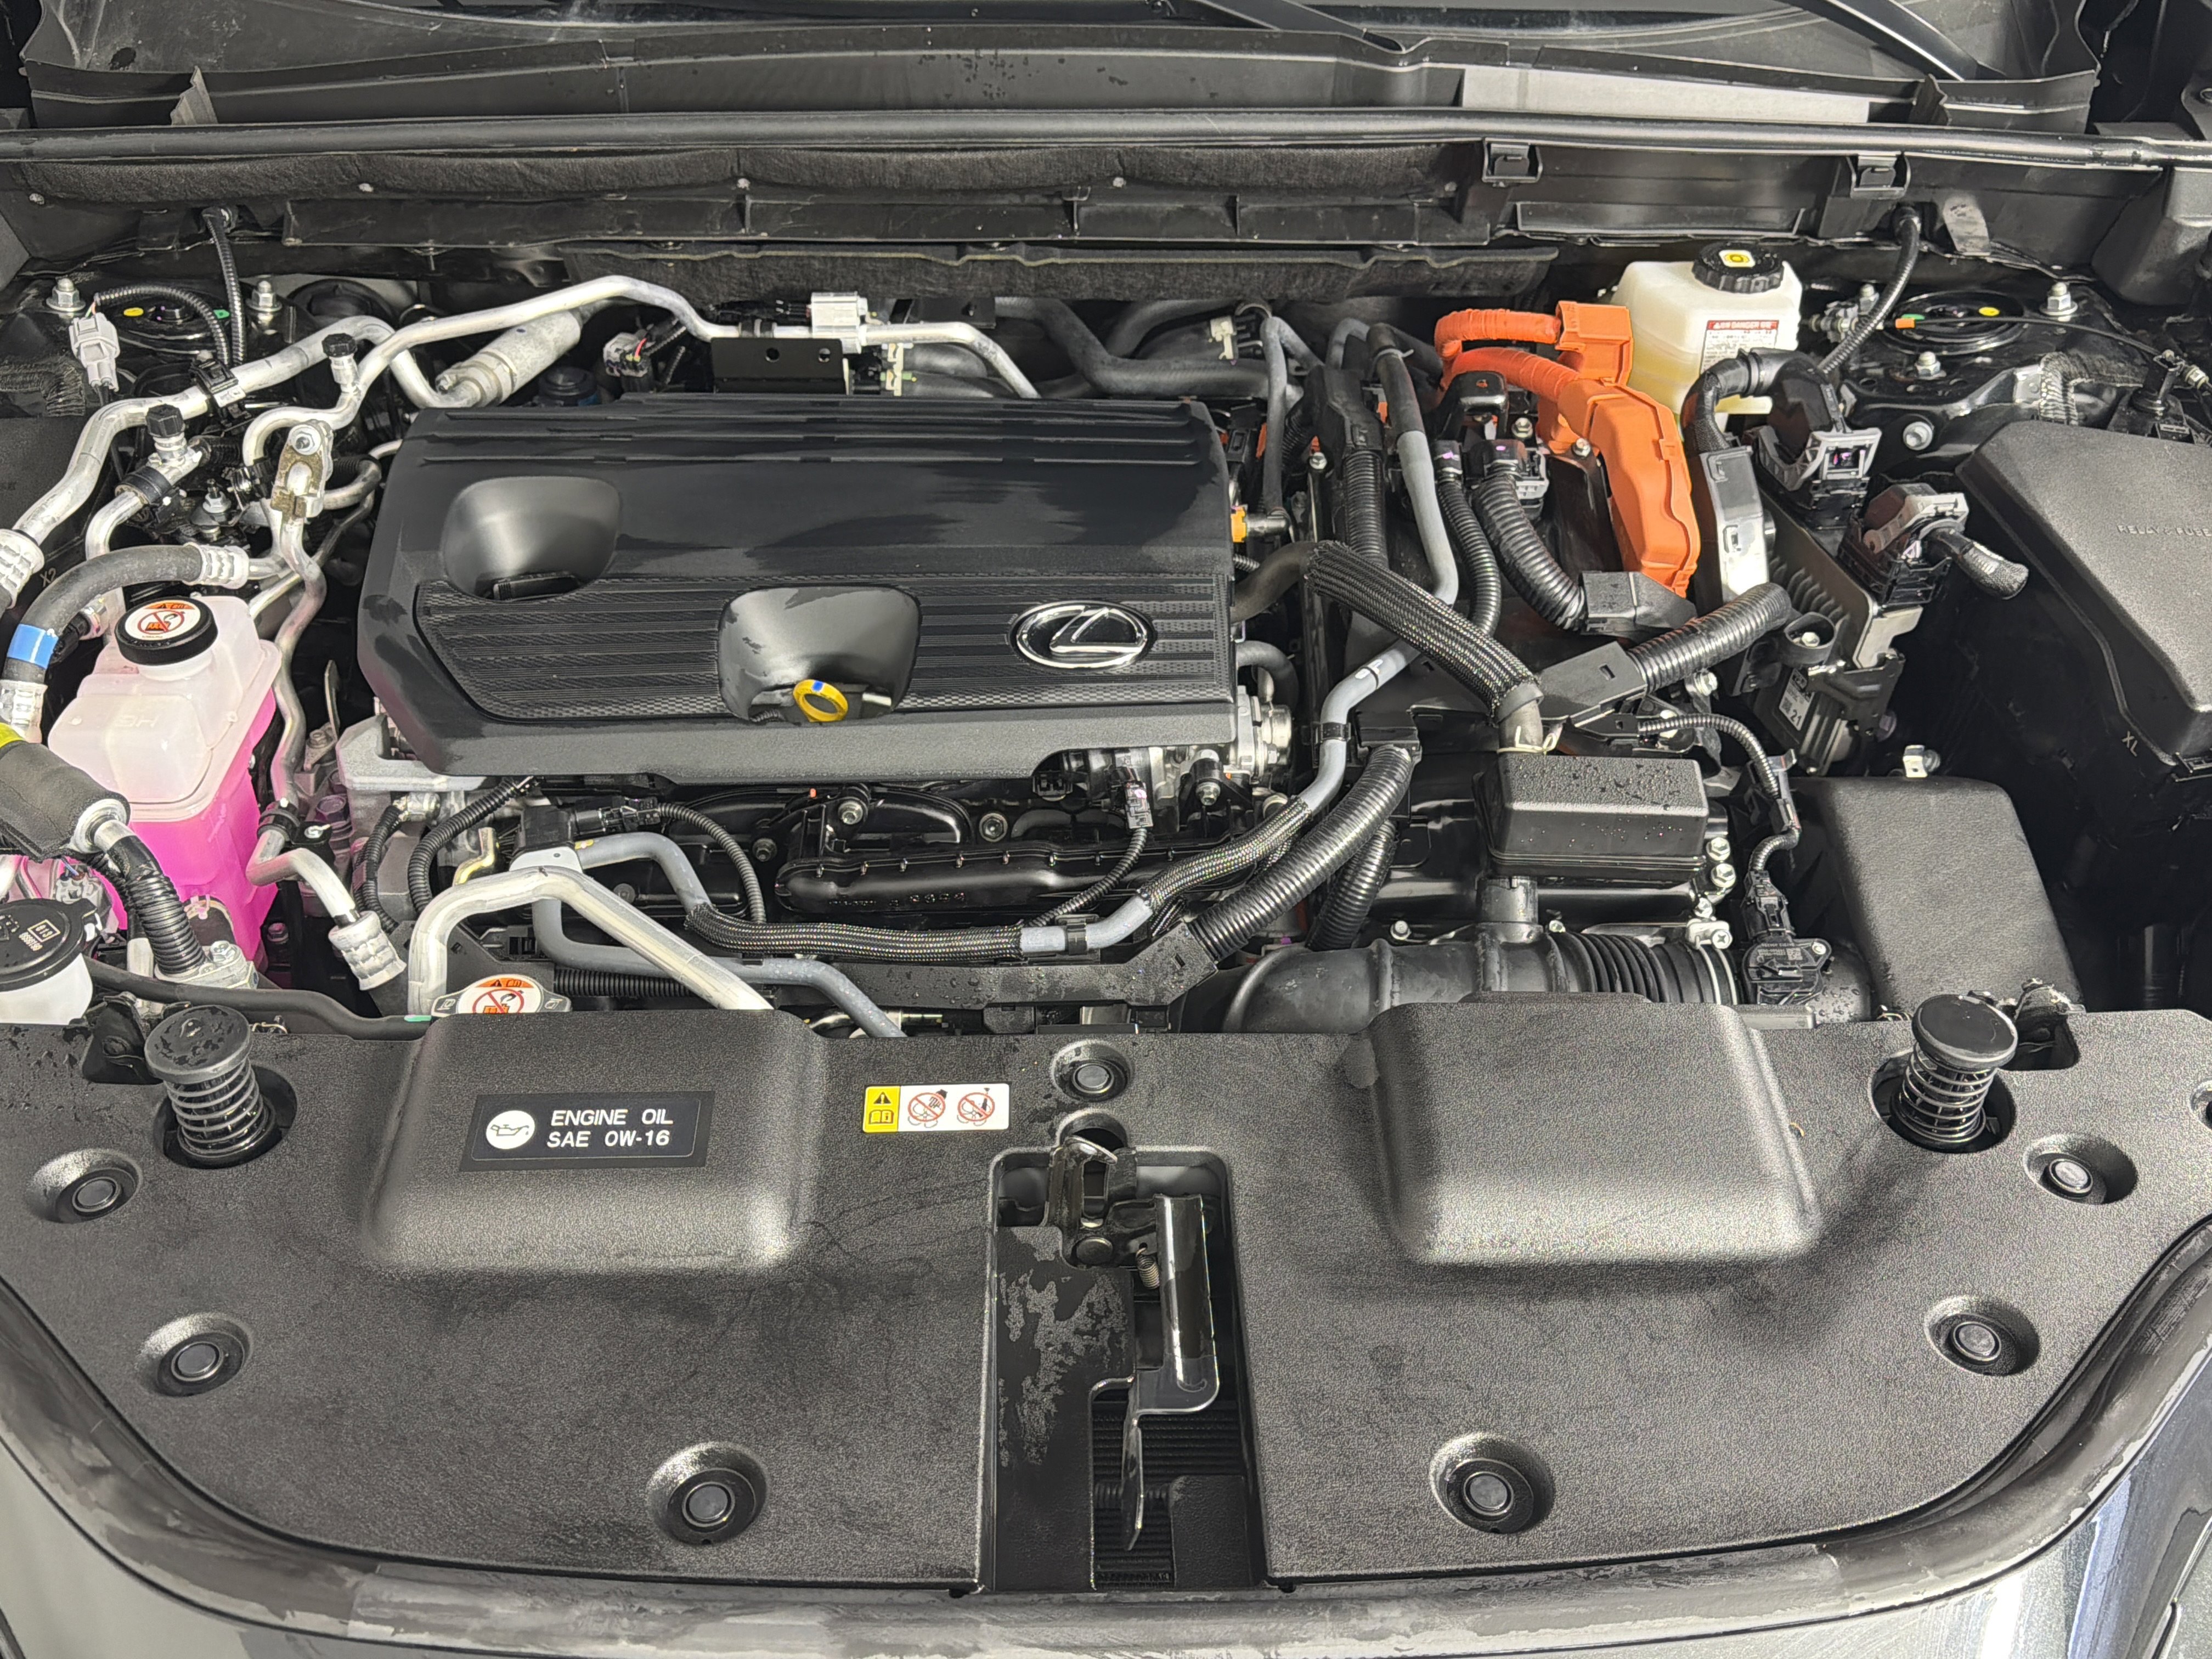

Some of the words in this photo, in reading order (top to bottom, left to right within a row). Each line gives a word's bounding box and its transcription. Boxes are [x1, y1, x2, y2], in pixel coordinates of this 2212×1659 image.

[2117, 524, 2159, 534] RELAY
[2175, 527, 2212, 537] FUSE
[1790, 709, 1802, 726] 21
[2121, 731, 2138, 757] XL
[550, 1109, 628, 1126] ENGINE
[641, 1108, 674, 1125] OIL
[546, 1131, 591, 1148] SAE
[604, 1129, 670, 1147] 0W-16
